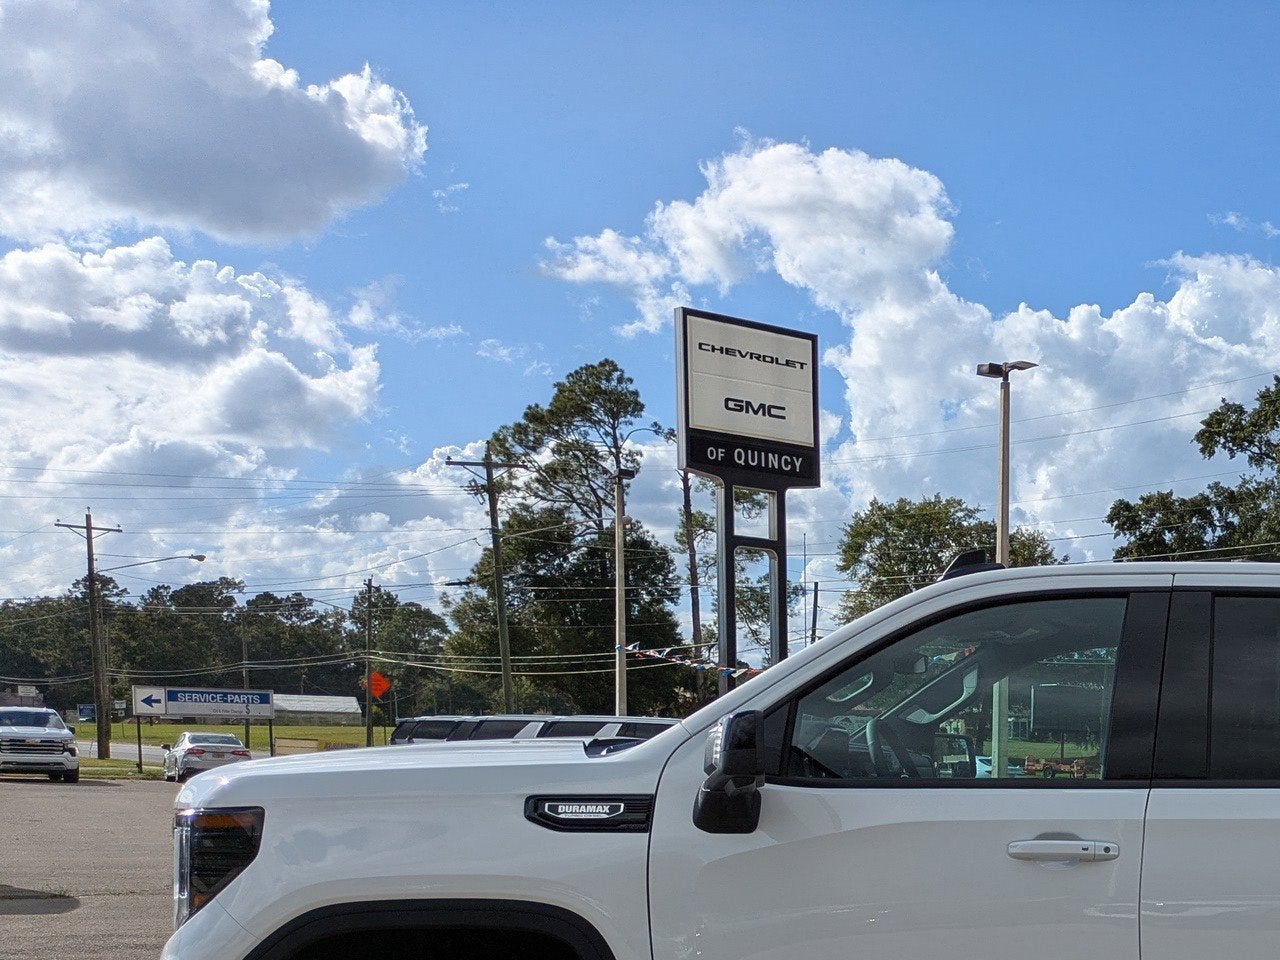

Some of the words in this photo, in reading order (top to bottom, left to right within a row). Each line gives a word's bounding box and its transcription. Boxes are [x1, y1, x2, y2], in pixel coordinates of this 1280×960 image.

[698, 342, 807, 370] CHEVROLET
[724, 397, 786, 420] GMC
[707, 446, 726, 461] OF
[734, 448, 802, 473] QUINCY
[177, 692, 260, 704] SERVICE-PARTS
[558, 805, 610, 813] DURAMAX
